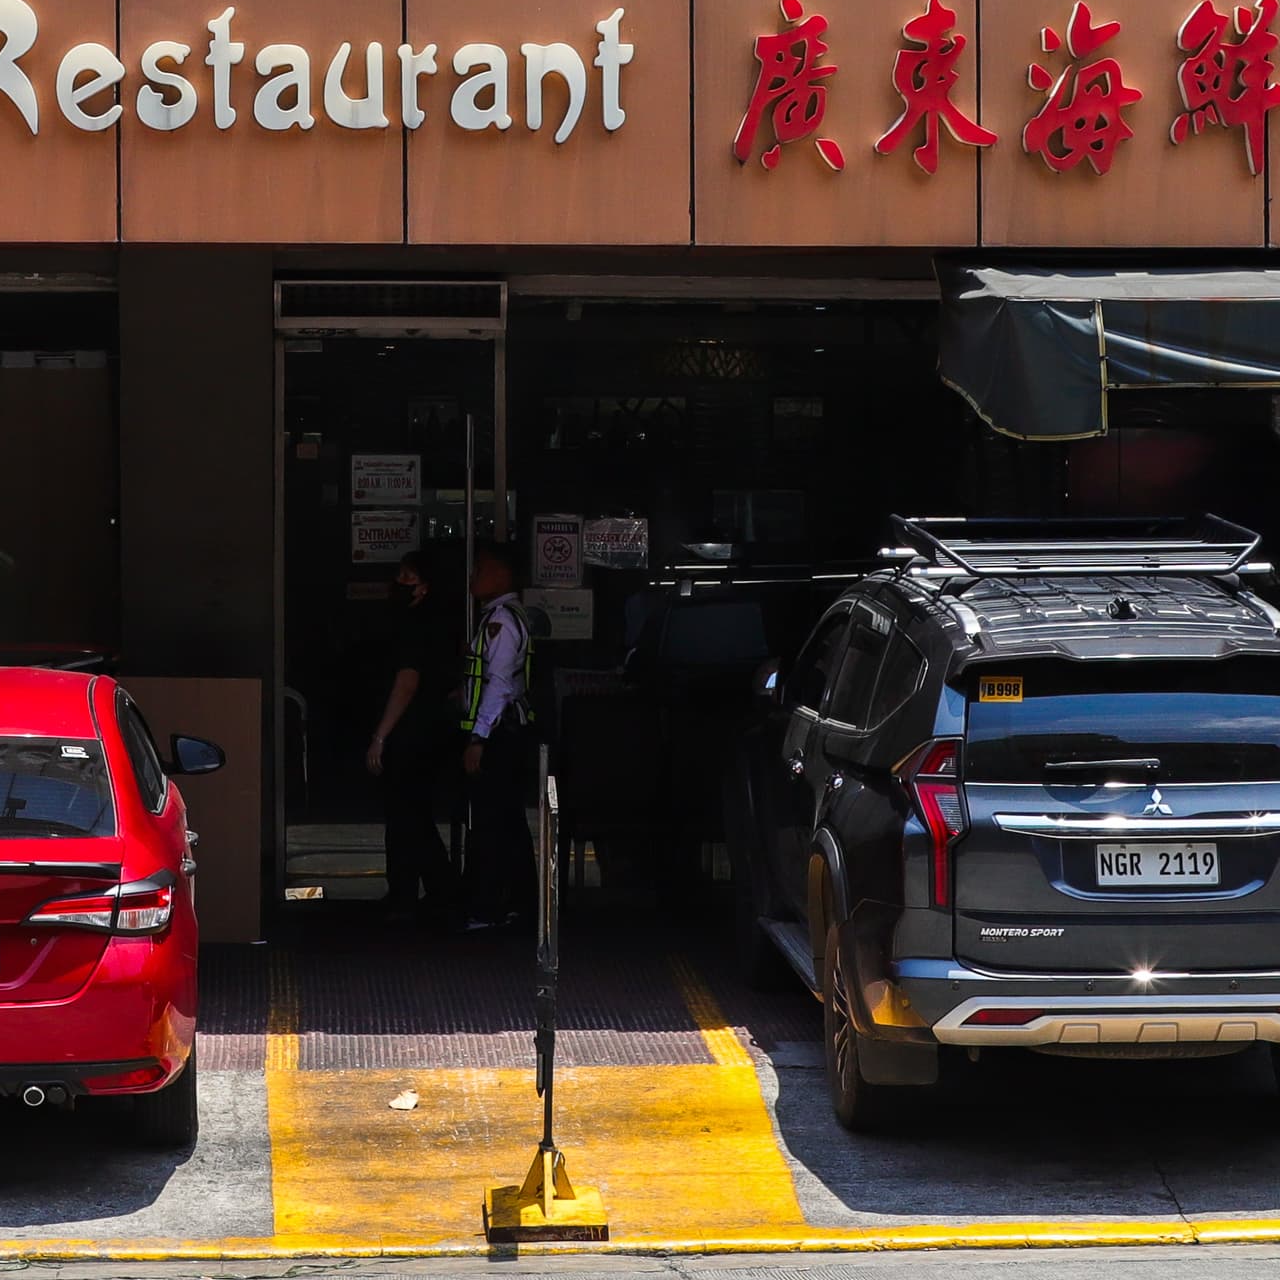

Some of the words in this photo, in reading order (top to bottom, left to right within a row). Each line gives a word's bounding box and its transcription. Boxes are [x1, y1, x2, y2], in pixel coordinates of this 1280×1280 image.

[358, 527, 411, 540] ENTRANCE
[1101, 852, 1141, 876] NGR
[1159, 852, 1215, 876] 2119
[980, 927, 1028, 937] MONTERO
[1029, 927, 1065, 937] SPORT
